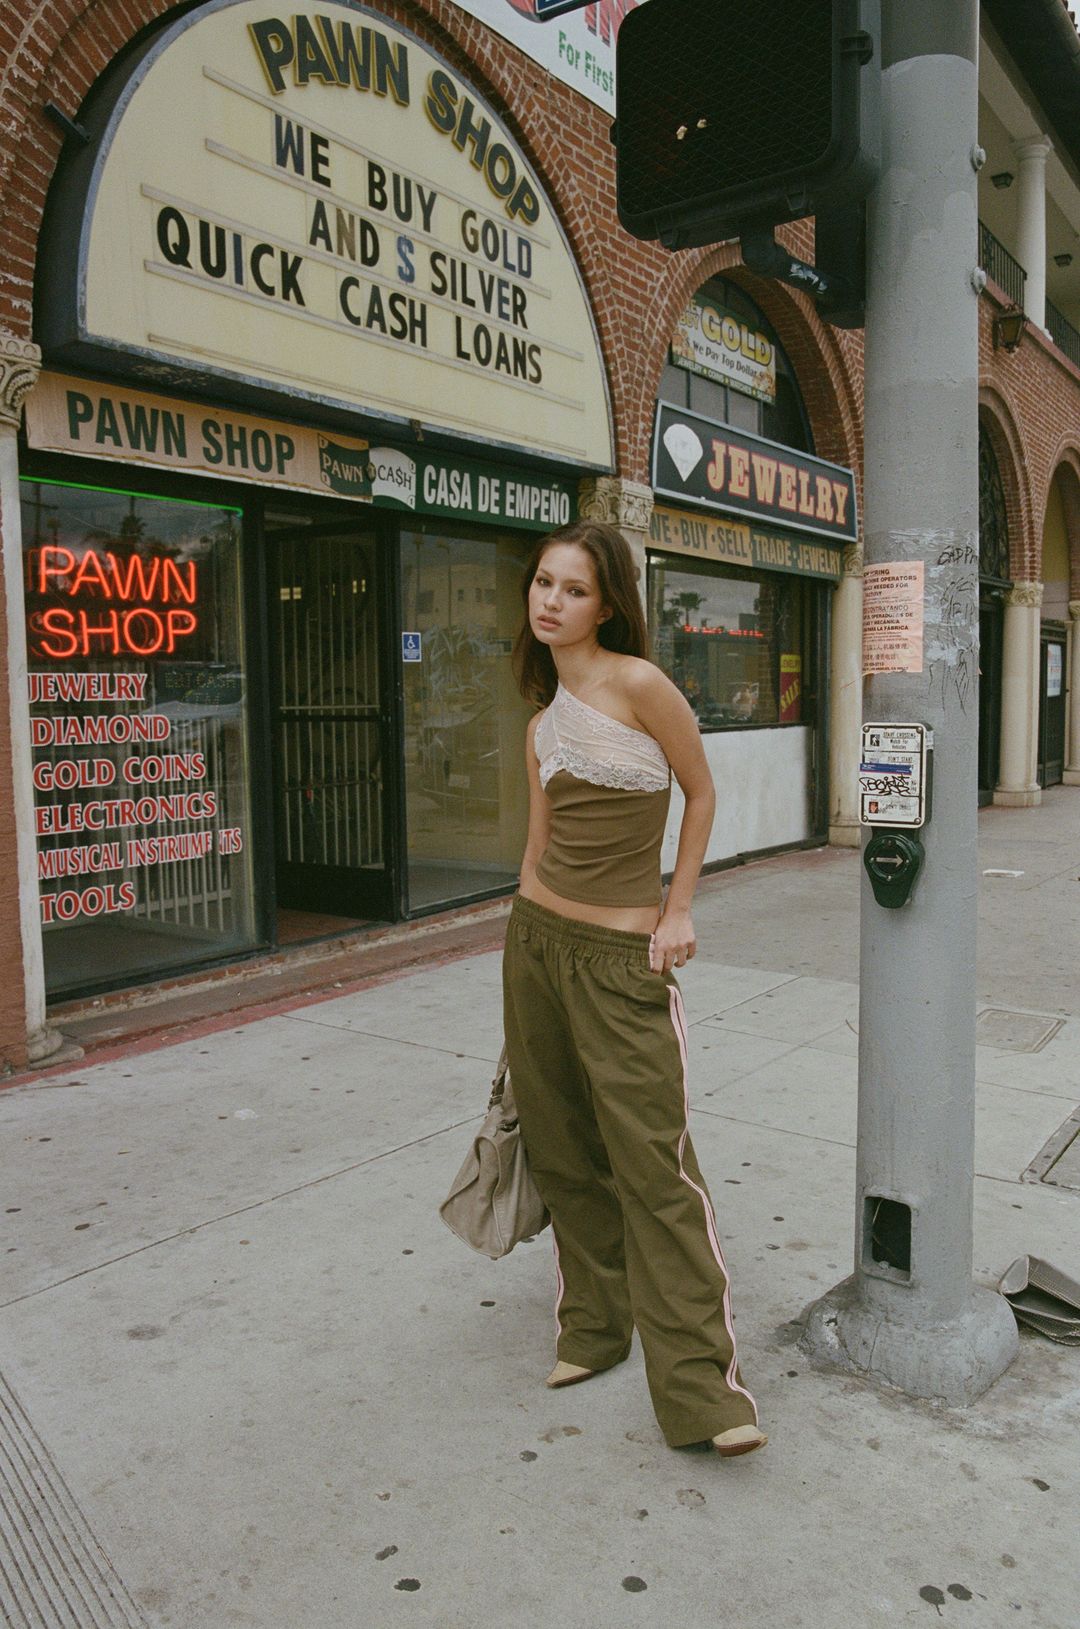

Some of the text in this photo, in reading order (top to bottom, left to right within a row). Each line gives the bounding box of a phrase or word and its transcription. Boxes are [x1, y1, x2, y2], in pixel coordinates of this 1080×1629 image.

[558, 29, 614, 97] For First
[247, 14, 541, 226] PAWN SHOP
[274, 113, 532, 279] WE BUY GOLD
[309, 199, 528, 330] AND $ SILVER
[156, 206, 543, 385] QUICK CASH LOANS
[701, 306, 772, 367] GOLD
[66, 390, 296, 476] PAWN SHOP
[322, 452, 364, 484] PAWN
[423, 463, 474, 512] CASA
[478, 475, 501, 516] DE
[505, 480, 571, 526] EMPEÑO
[707, 438, 849, 526] JEWELRY
[680, 517, 709, 551] BUY
[717, 526, 749, 558] SELL
[753, 534, 842, 577] TRADE JEWELRY
[38, 545, 197, 604] PAWN
[40, 607, 198, 658] SHOP
[28, 672, 149, 704] JEWELRY
[30, 714, 171, 747] DIAMOND
[32, 752, 207, 792] GOLD COINS
[34, 792, 217, 836] ELECTRONICS
[38, 841, 124, 881] MUSICAL
[39, 880, 137, 925] TOOLS
